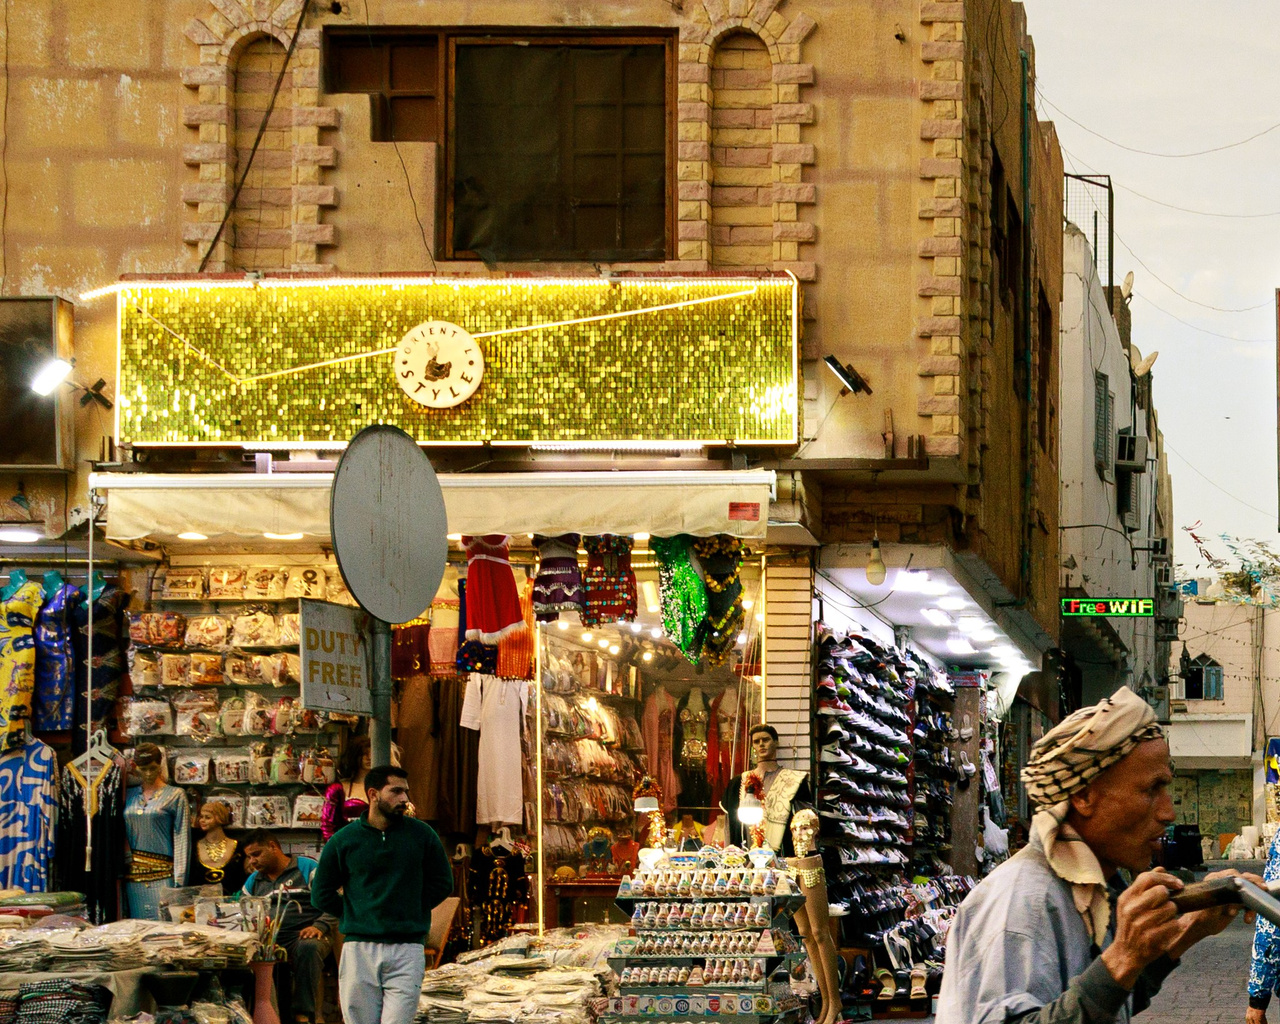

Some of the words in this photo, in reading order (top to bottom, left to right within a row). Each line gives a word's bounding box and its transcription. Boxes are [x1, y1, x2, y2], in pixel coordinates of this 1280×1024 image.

[401, 370, 473, 401] STYLE
[1070, 599, 1106, 614] Free
[305, 626, 361, 657] DUTY
[308, 660, 362, 689] FREE
